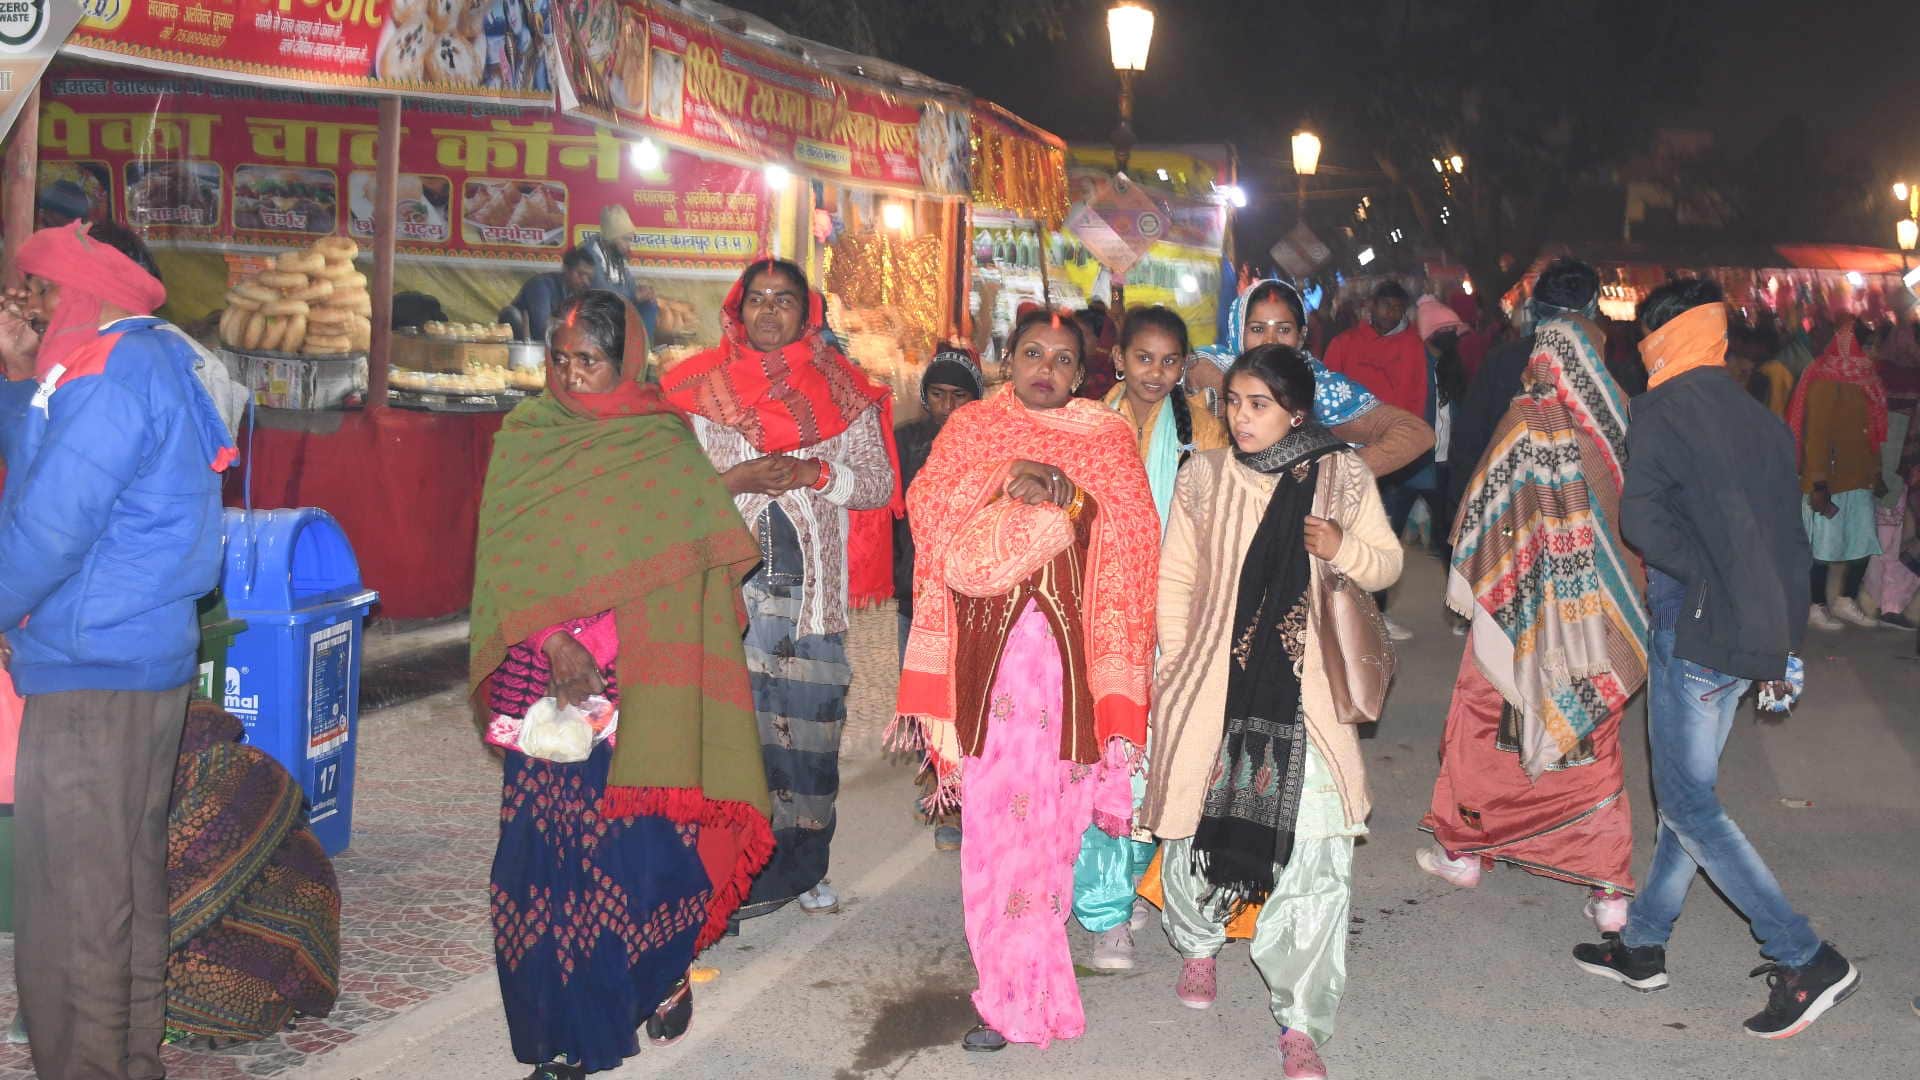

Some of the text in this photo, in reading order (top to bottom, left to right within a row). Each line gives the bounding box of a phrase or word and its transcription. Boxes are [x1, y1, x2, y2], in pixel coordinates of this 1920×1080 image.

[0, 2, 29, 13] ZERO
[0, 13, 30, 22] WASTE
[484, 224, 545, 241] समोसा
[320, 764, 337, 794] 17
